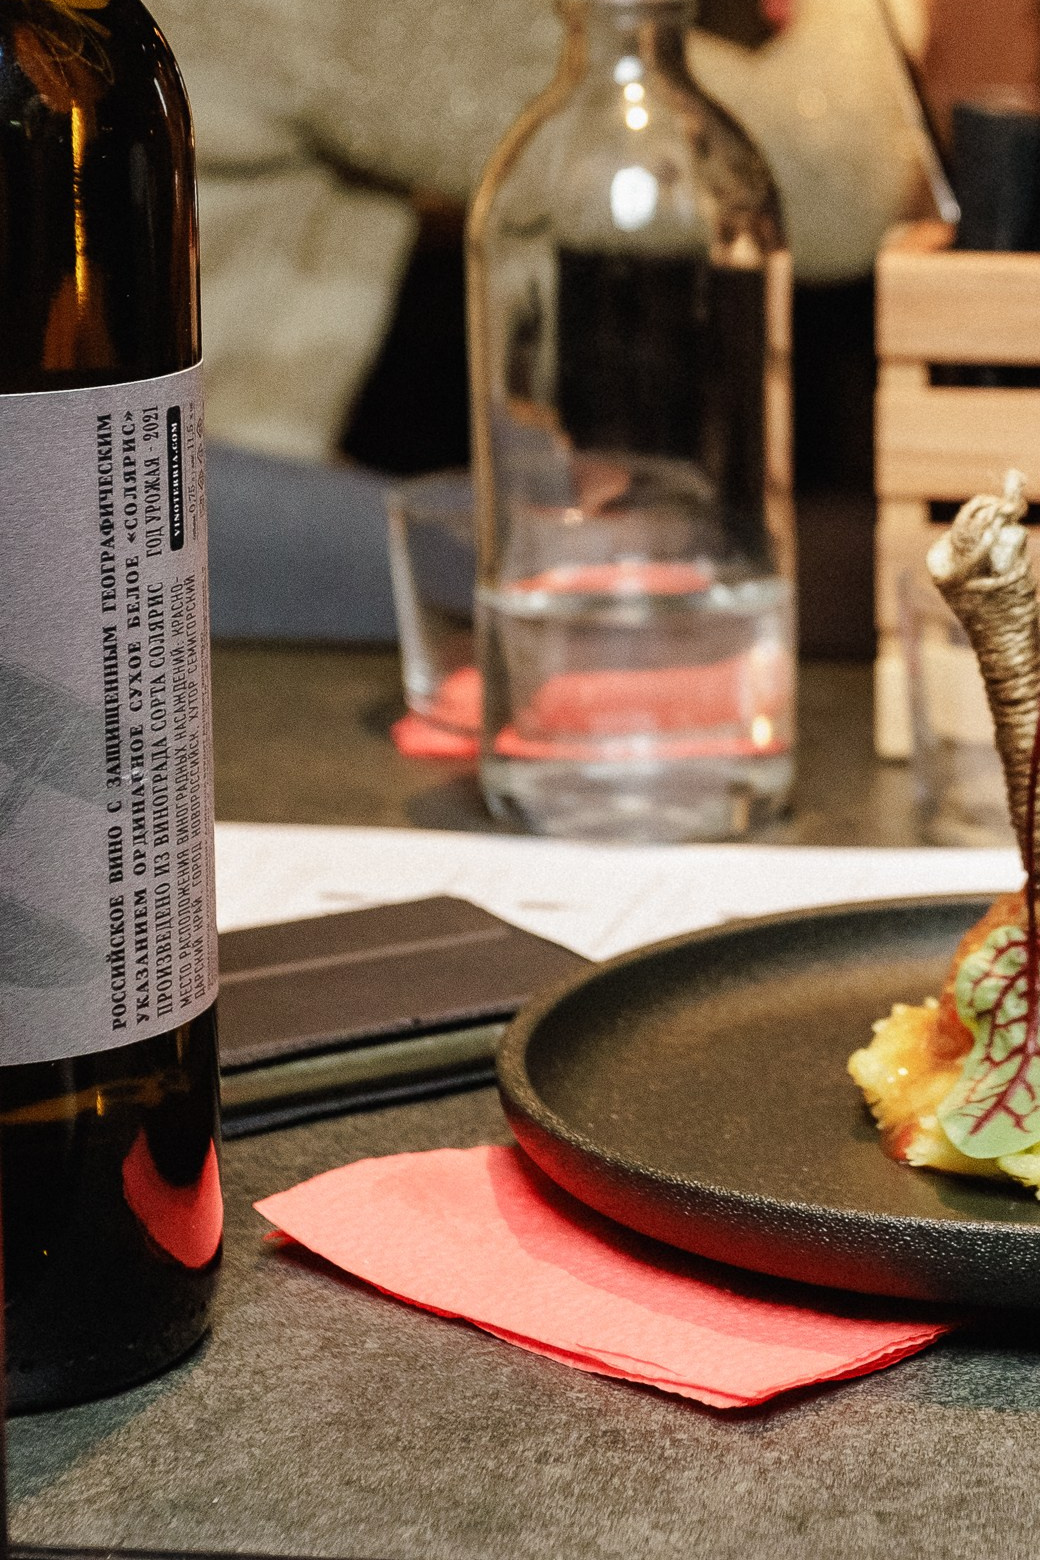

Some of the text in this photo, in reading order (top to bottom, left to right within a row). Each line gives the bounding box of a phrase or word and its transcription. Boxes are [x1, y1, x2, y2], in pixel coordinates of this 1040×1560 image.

[142, 405, 159, 441] 2021
[144, 457, 161, 524] УРОЖАЯ
[171, 422, 181, 536] VINOTERRIA.COM
[146, 525, 164, 557] ГОД
[97, 414, 126, 1030] РОССИЙСКОЕ ВИНО С ЗАЩИЩЕННЫМ ГЕОГРАФИЧЕСКИМ
[121, 411, 150, 1024] УКАЗАНИЕМ ОРДИНАРНОЕ СУХОЕ БЕЛОЕ «СОЛЯРИС»
[189, 681, 199, 719] ХУТОР
[147, 582, 174, 1018] ПРОИЗВЕДЕНО ИЗ ВИНОГРАДА СОРТА СОЛЯРИС
[170, 577, 193, 1008] МЕСТО РАСПОЛОЖЕНИЯ ВИНОГРАДНЫХ НАСАЖДЕНИЙ: КРАСНО-
[190, 841, 203, 887] ГОРОД
[192, 935, 206, 999] ДАРСКИЙ
